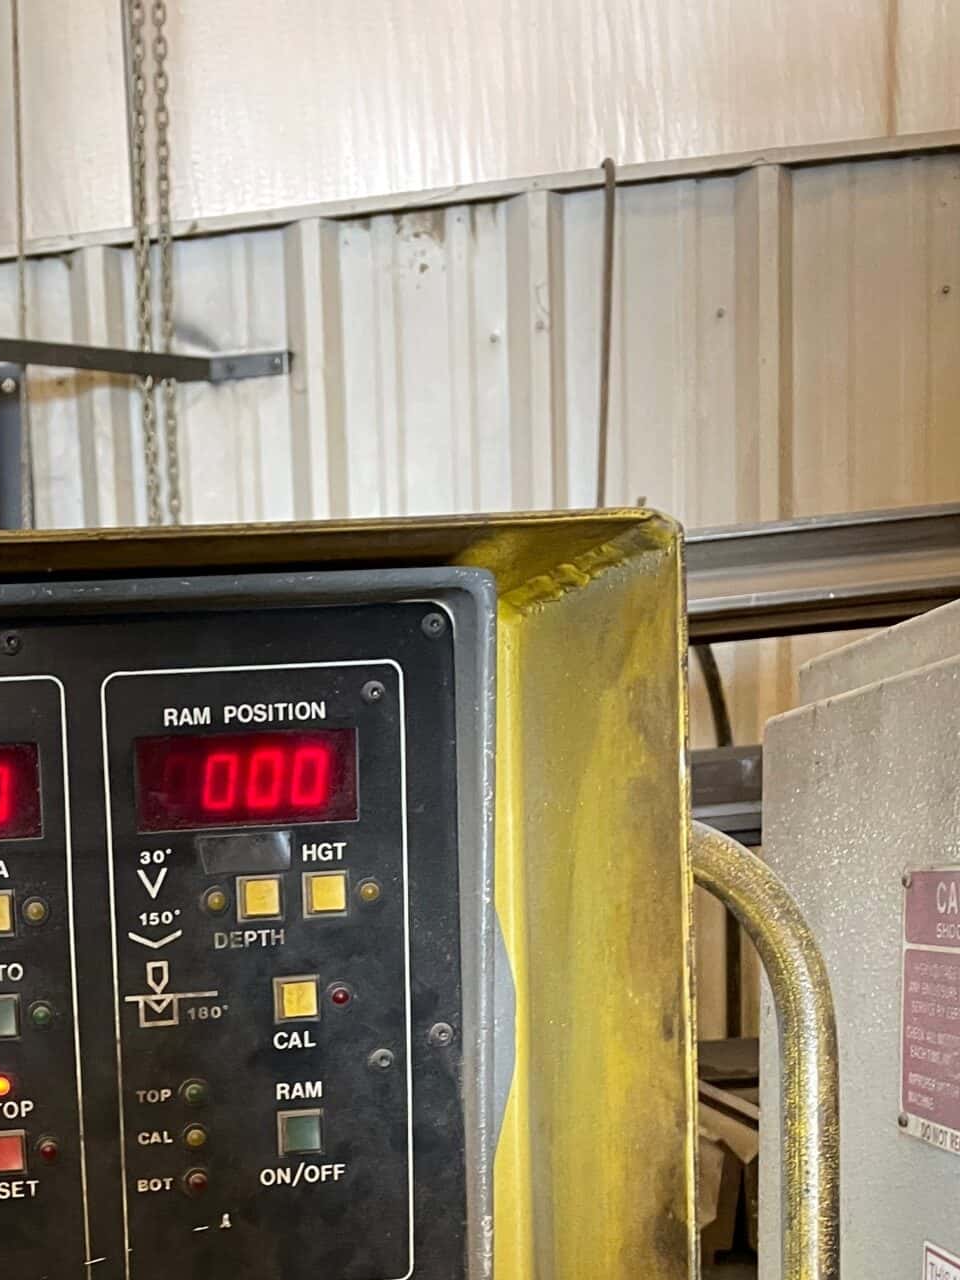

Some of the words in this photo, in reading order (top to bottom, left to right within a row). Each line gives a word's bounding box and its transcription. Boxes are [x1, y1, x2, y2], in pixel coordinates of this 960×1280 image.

[164, 707, 211, 727] RAM
[223, 701, 327, 724] POSITION
[203, 747, 328, 810] 000
[302, 843, 347, 862] HGT
[214, 929, 285, 949] DEPTH
[273, 1031, 316, 1049] CAL
[136, 1089, 172, 1103] TOP
[276, 1081, 323, 1100] RAM
[138, 1131, 174, 1144] CAL
[259, 1163, 346, 1187] ON/OFF
[136, 1178, 174, 1192] BOT
